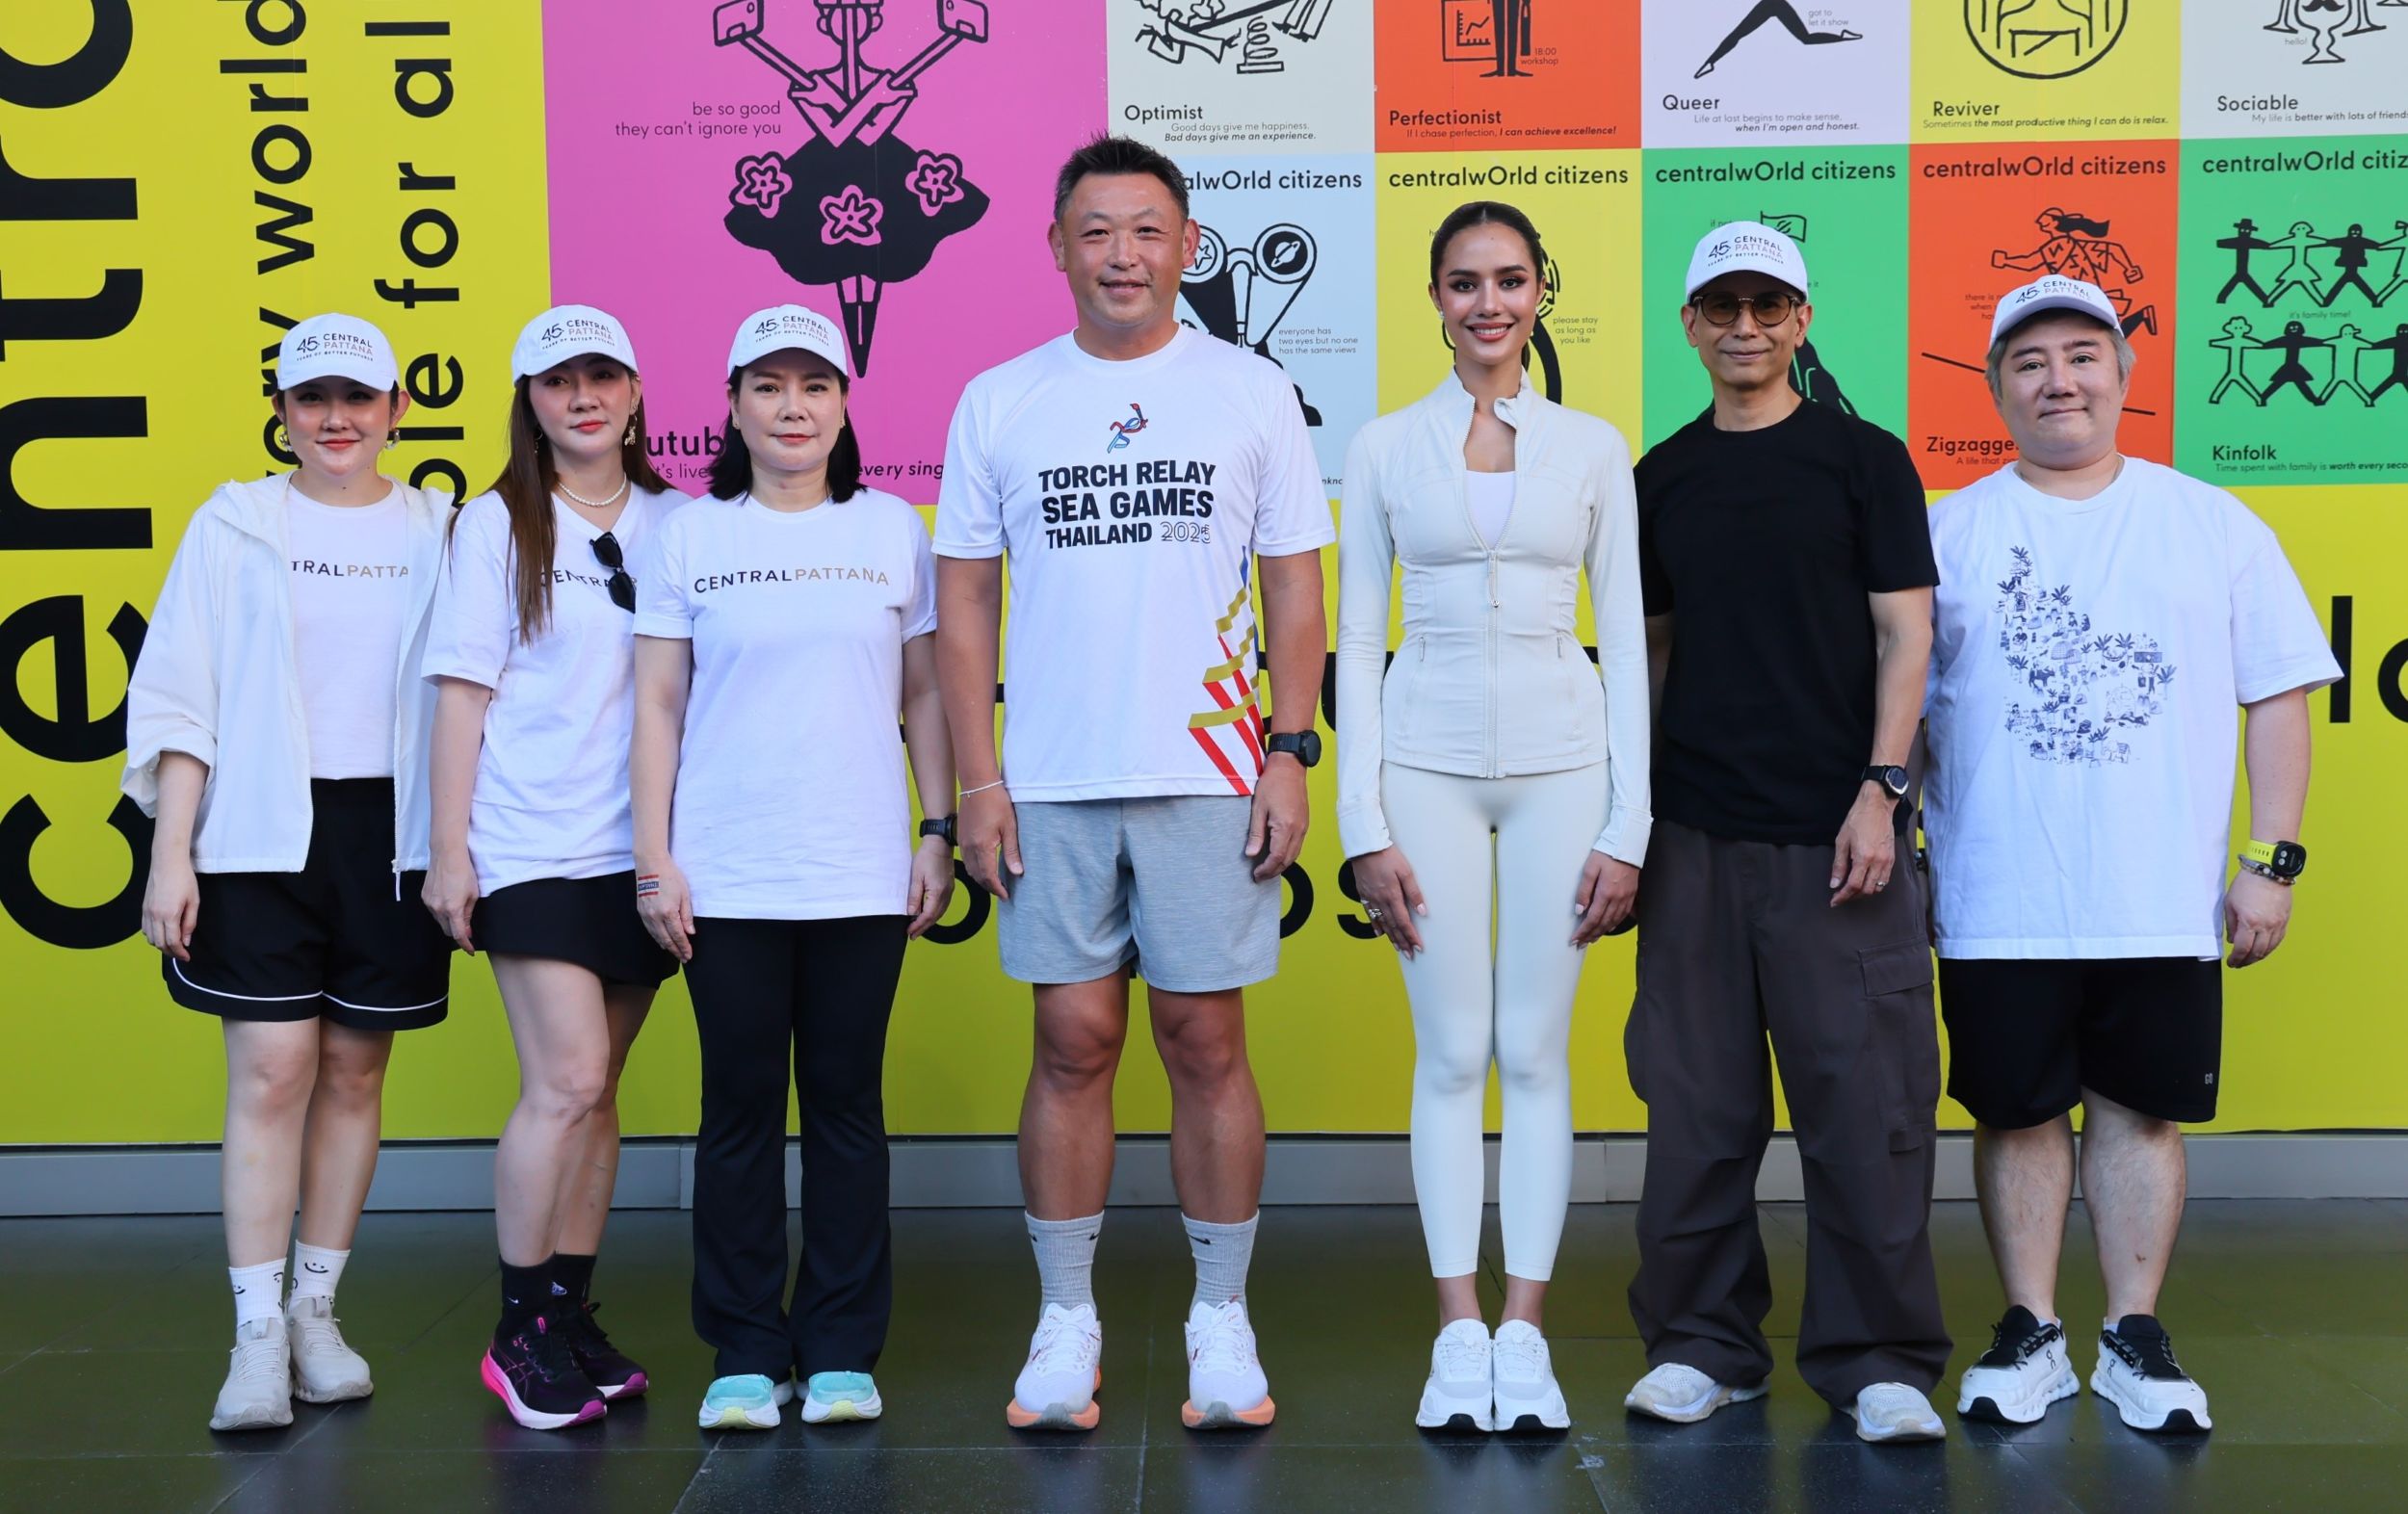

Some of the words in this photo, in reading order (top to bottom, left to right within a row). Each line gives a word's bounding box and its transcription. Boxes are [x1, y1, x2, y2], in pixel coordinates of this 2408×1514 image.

[693, 101, 712, 116] be
[718, 104, 735, 116] so
[740, 100, 781, 118] good
[1662, 94, 1720, 111] Queer
[1933, 100, 2001, 117] Reviver
[2217, 93, 2299, 112] Sociable
[1124, 104, 1203, 124] Optimist
[1389, 109, 1502, 126] Perfectionist
[1694, 115, 1711, 123] Life
[1724, 114, 1741, 122] last
[1742, 114, 1773, 124] begins
[1775, 114, 1784, 122] to
[1786, 113, 1813, 121] make
[1923, 118, 1973, 128] Sometimes
[1974, 118, 1989, 127] the
[1991, 118, 2014, 127] most
[2015, 117, 2065, 129] productive
[2067, 117, 2092, 128] thing
[2119, 116, 2132, 125] do
[2133, 116, 2141, 124] is
[2142, 115, 2169, 124] relax.
[2252, 114, 2266, 124] My
[2268, 113, 2283, 122] life
[2285, 113, 2292, 121] is
[2294, 112, 2323, 122] better
[2325, 111, 2345, 121] with
[2348, 111, 2365, 120] lots
[2367, 110, 2378, 120] of
[615, 121, 649, 140] they
[654, 120, 694, 136] can't
[698, 121, 748, 139] ignore
[753, 123, 781, 138] you
[1171, 122, 1196, 132] Good
[1199, 122, 1220, 134] days
[1223, 122, 1243, 134] give
[1262, 121, 1310, 134] happiness.
[1420, 129, 1448, 138] chase
[1450, 128, 1498, 140] perfection,
[1525, 126, 1561, 137] achieve
[1563, 126, 1617, 136] excellence!
[1735, 123, 1761, 132] when
[1779, 124, 1804, 134] open
[1805, 122, 1824, 131] and
[1825, 121, 1860, 131] honest.
[1165, 133, 1183, 142] Bad
[1186, 133, 1208, 144] days
[1210, 132, 1229, 144] give
[1248, 132, 1260, 141] an
[1262, 131, 1317, 143] experience.
[1923, 155, 2075, 178] centralwOrld
[2081, 155, 2166, 175] citizens
[2202, 149, 2355, 173] centralwOrld
[1278, 170, 1362, 190] citizens
[1389, 166, 1538, 188] centralwOrld
[1544, 166, 1629, 185] citizens
[1655, 161, 1805, 183] centralwOrld
[1811, 160, 1897, 181] citizens
[374, 162, 459, 309] for
[1734, 235, 1783, 252] CENTRAL
[1708, 241, 1731, 259] 45
[1735, 244, 1783, 259] PATTANA
[2015, 285, 2040, 304] 45
[2043, 280, 2090, 298] CENTRAL
[566, 320, 612, 333] CENTRAL
[754, 318, 780, 335] 45
[782, 315, 828, 333] CENTRAL
[1553, 317, 1580, 326] please
[1582, 317, 1598, 326] stay
[541, 323, 564, 342] 45
[568, 327, 614, 340] PATTANA
[783, 323, 829, 340] PATTANA
[1278, 327, 1316, 337] everyone
[1317, 326, 1332, 335] has
[1566, 326, 1584, 335] long
[297, 335, 320, 353] 45
[323, 332, 373, 349] CENTRAL
[324, 341, 374, 355] PATTANA
[1295, 338, 1314, 347] eyes
[1315, 336, 1329, 345] but
[1278, 347, 1294, 355] has
[1310, 347, 1333, 355] same
[1334, 346, 1357, 354] views
[646, 427, 723, 457] utub
[1926, 436, 2019, 457] Zigzagge
[2212, 444, 2277, 461] Kinfolk
[1038, 464, 1128, 492] TORCH
[1136, 459, 1217, 486] RELAY
[2216, 463, 2238, 472] Time
[2240, 463, 2264, 474] spent
[2267, 462, 2288, 471] with
[2289, 462, 2317, 473] family
[2319, 462, 2327, 471] is
[2329, 461, 2356, 470] worth
[2358, 461, 2384, 472] every
[2386, 461, 2408, 470] seco
[1041, 492, 1101, 524] SEA
[1110, 487, 1215, 519] GAMES
[1046, 522, 1152, 549] THAILAND
